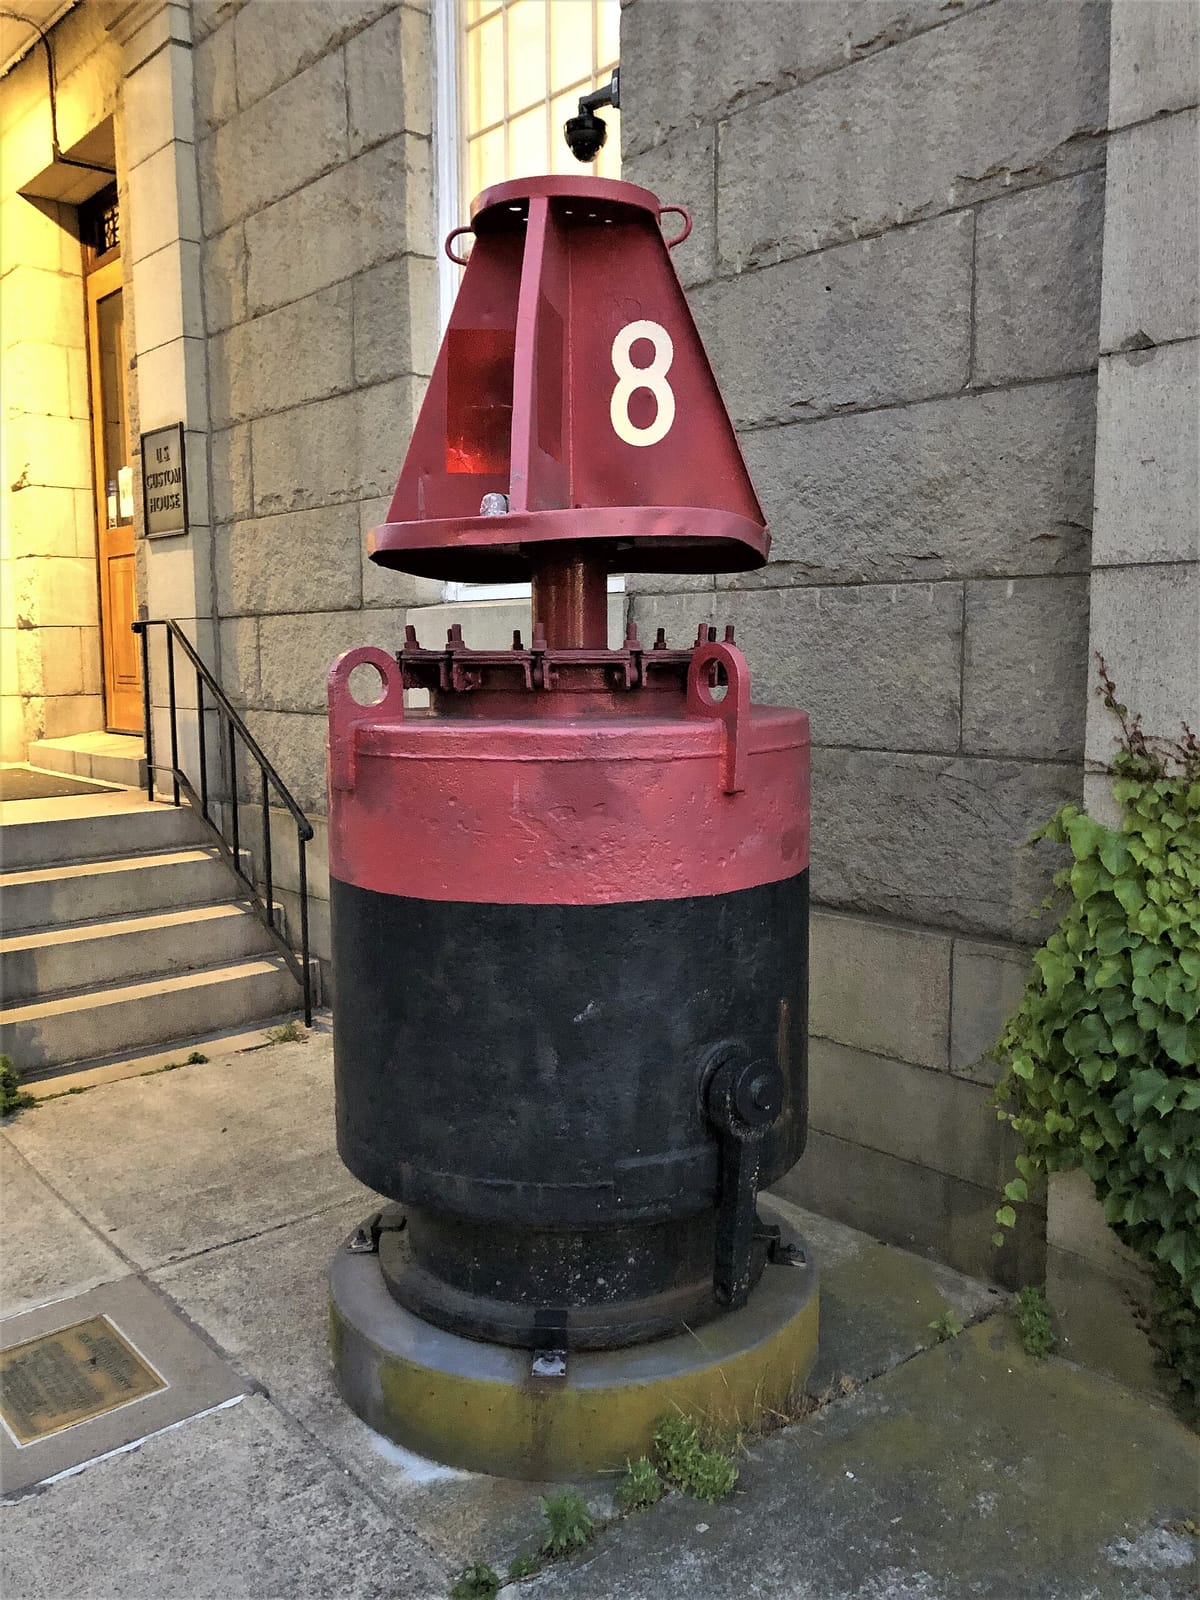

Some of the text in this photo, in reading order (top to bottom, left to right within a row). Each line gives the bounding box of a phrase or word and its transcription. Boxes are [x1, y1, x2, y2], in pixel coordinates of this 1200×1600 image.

[610, 319, 676, 447] 8
[146, 467, 181, 489] CUSTOM
[150, 493, 181, 513] HOUSE
